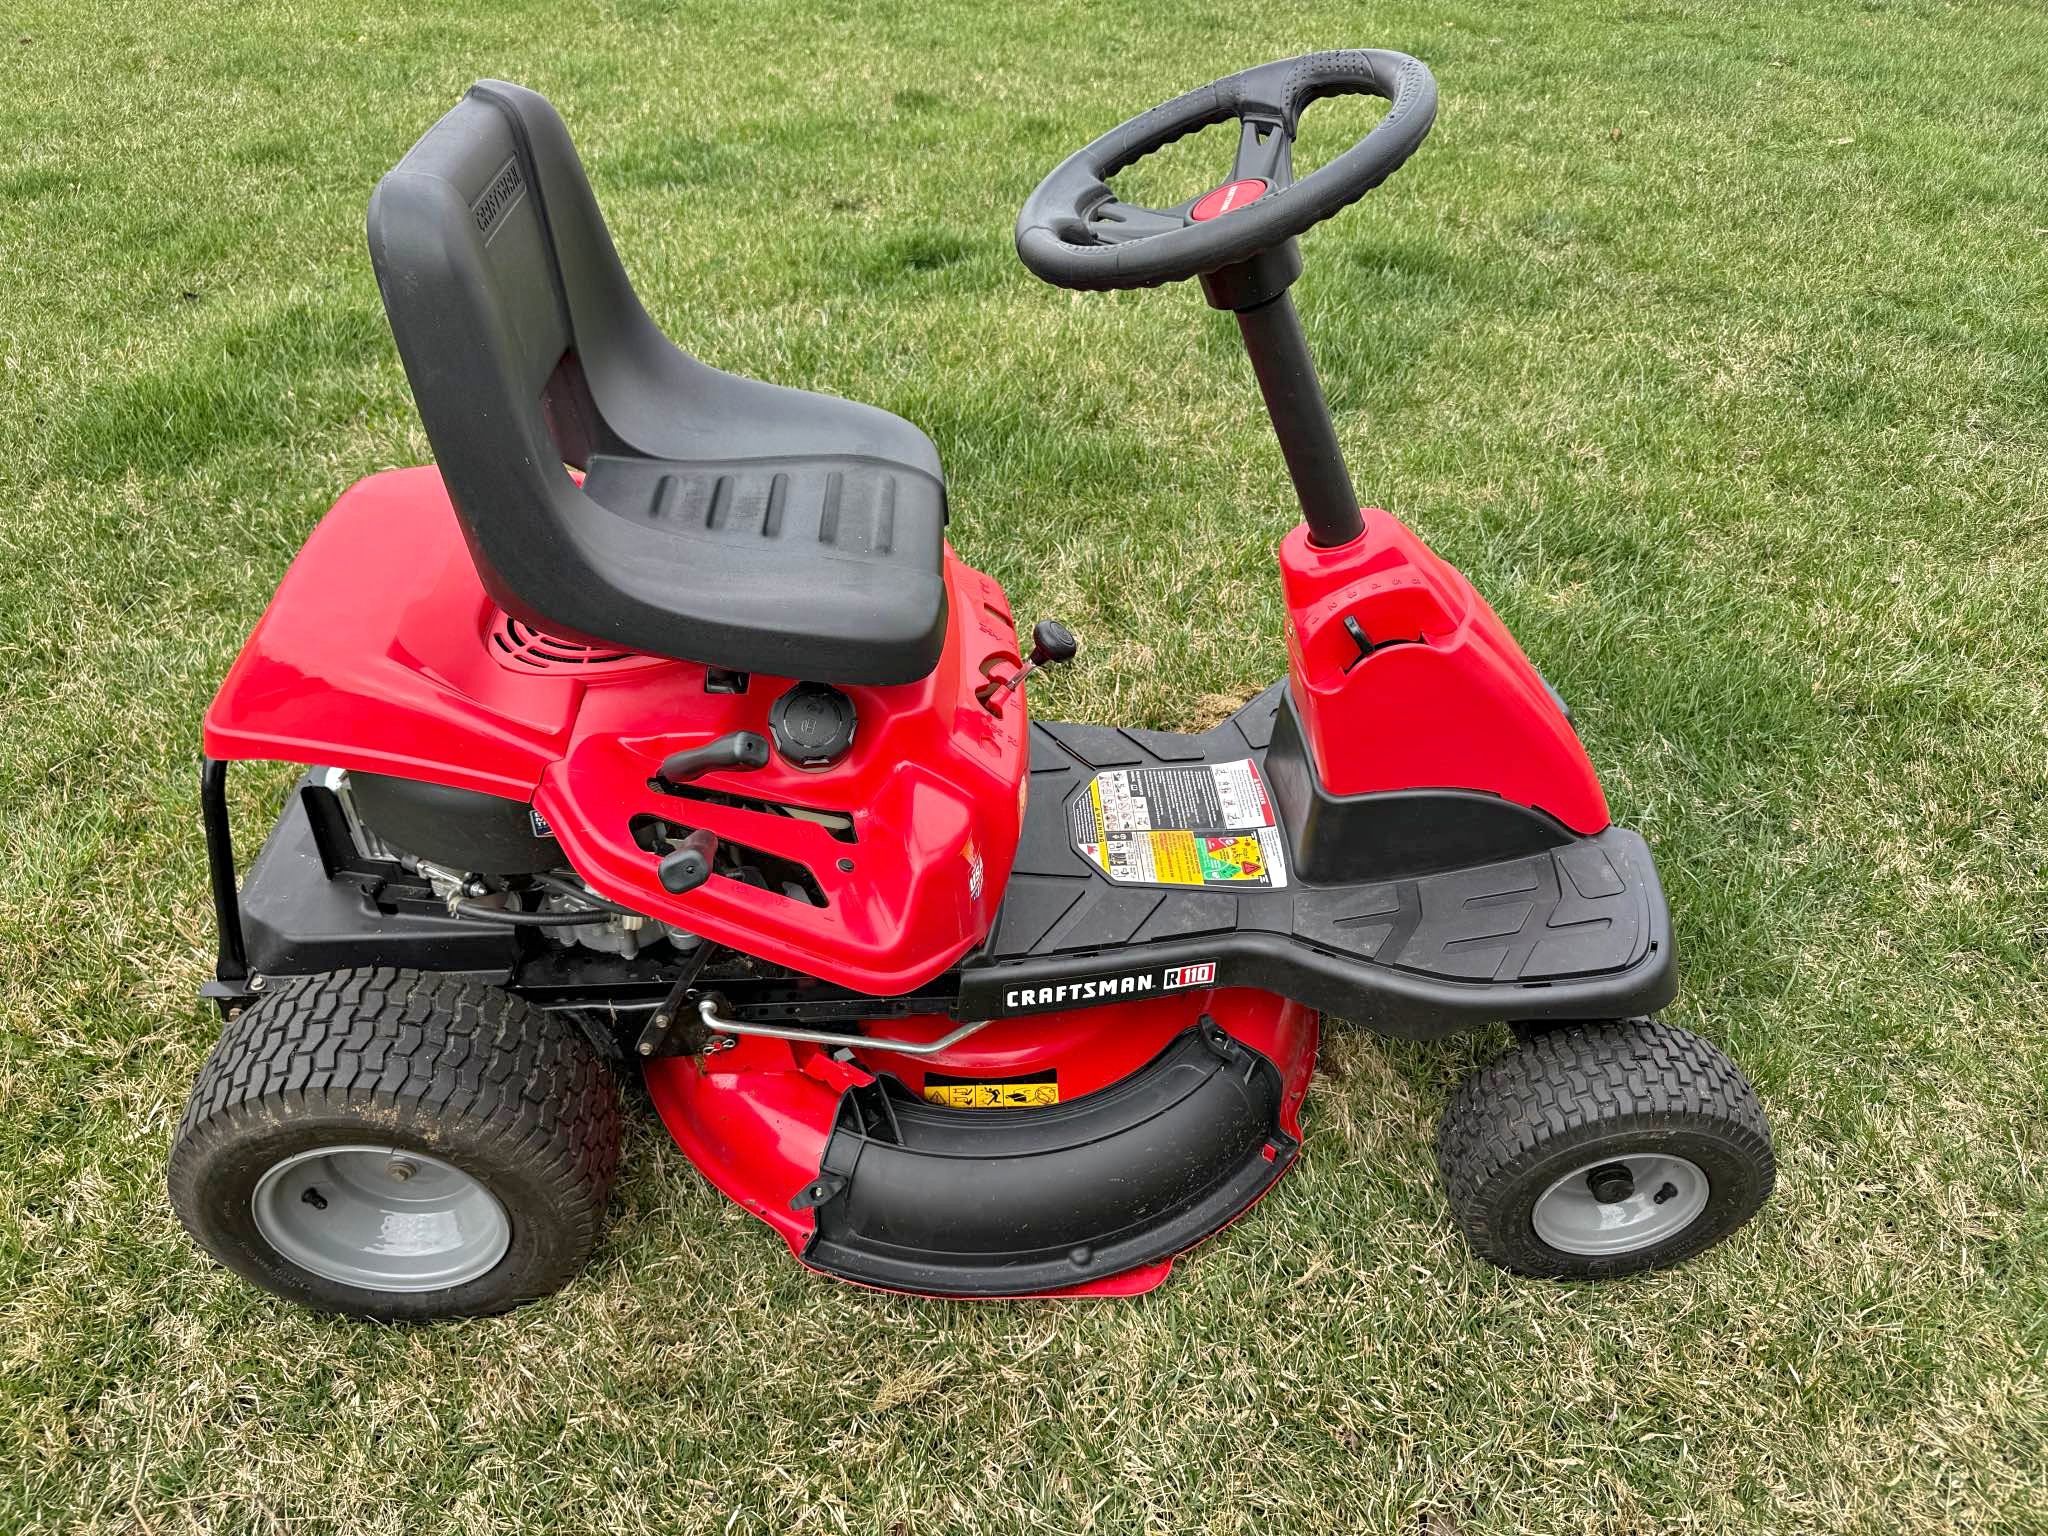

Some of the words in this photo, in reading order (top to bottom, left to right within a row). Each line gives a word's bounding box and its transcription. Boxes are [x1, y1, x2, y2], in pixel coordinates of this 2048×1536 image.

[1096, 813, 1105, 843] WARNING
[1006, 974, 1153, 1008] CRAFTSMAN
[1165, 965, 1210, 986] R110
